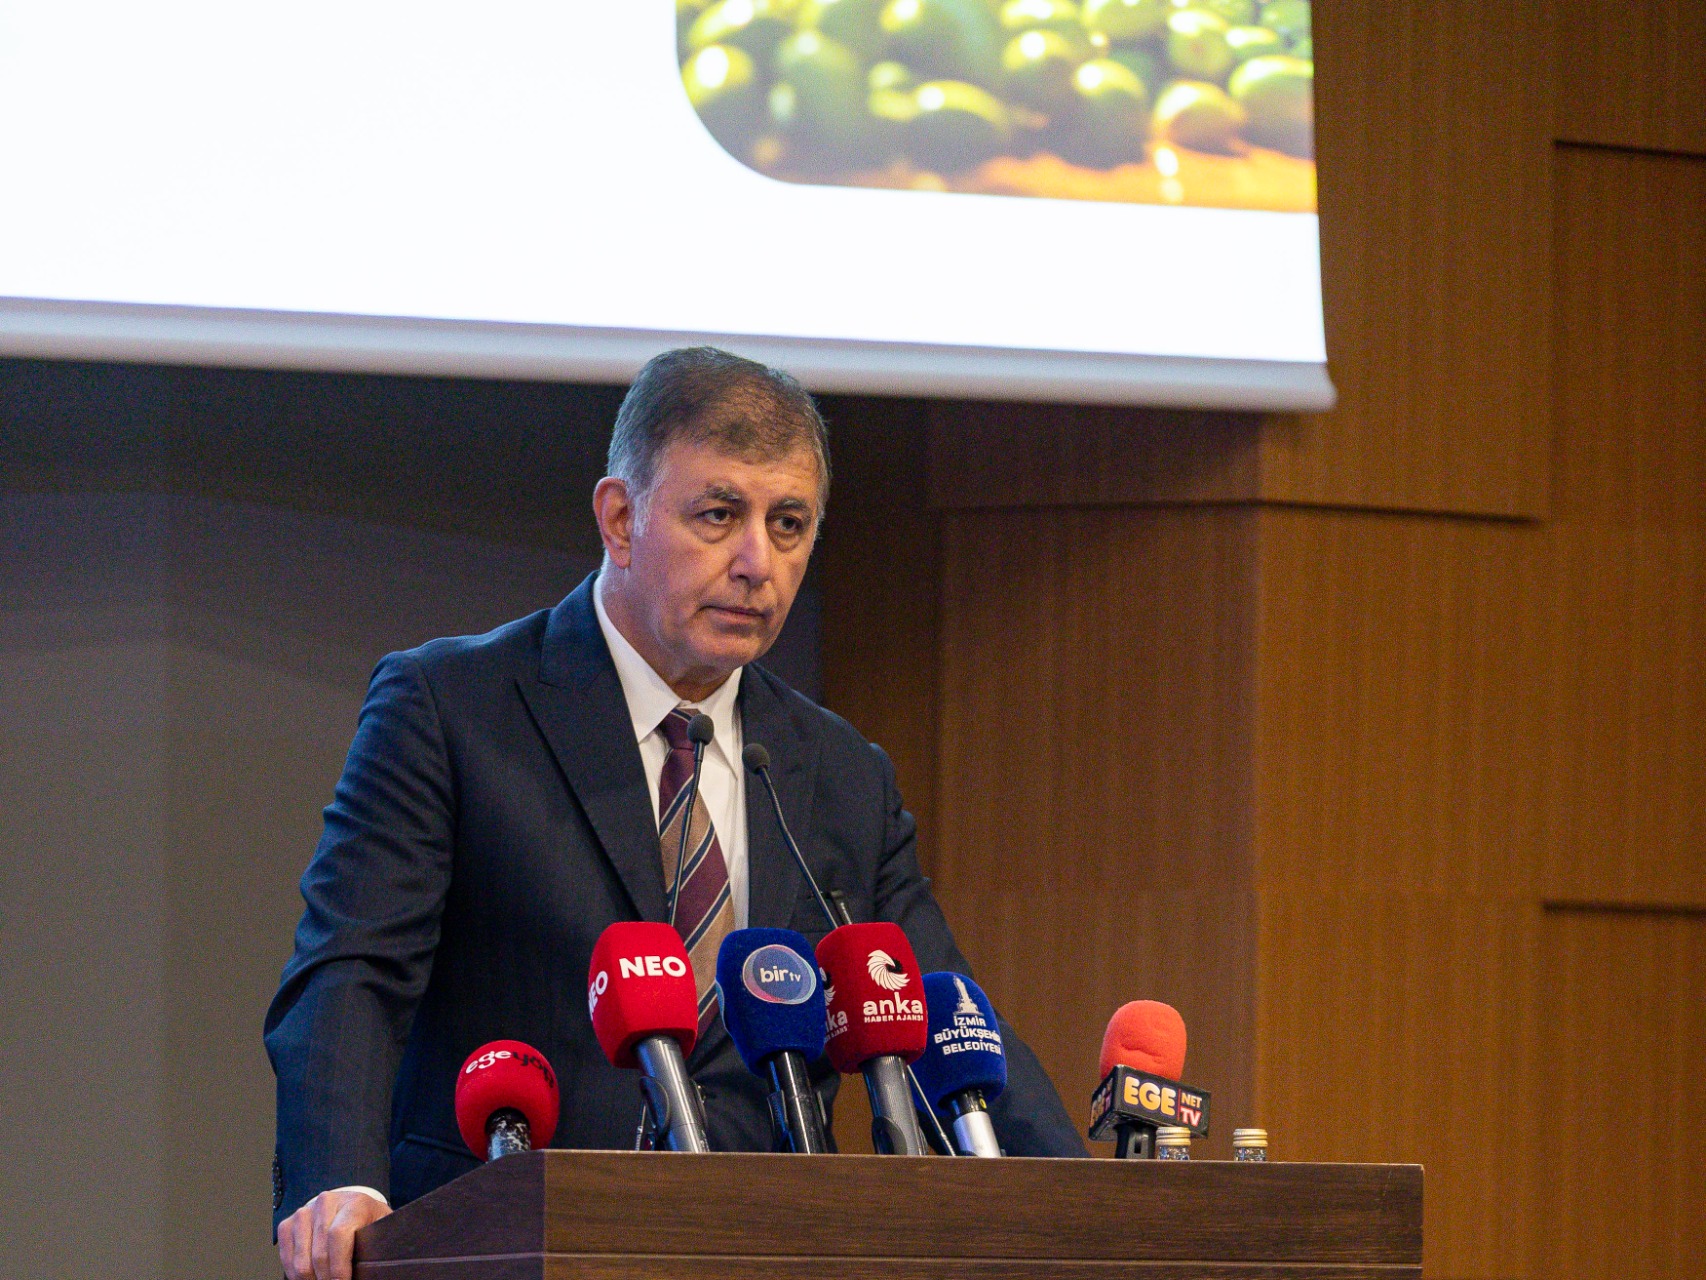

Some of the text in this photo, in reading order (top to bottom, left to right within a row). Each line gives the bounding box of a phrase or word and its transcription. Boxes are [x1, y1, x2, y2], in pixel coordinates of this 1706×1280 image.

[618, 955, 686, 979] NEO
[760, 965, 801, 983] bir tv
[863, 991, 923, 1015] anka
[864, 1015, 894, 1023] HABER
[953, 1015, 987, 1027] İZMİR
[942, 1039, 1002, 1056] BELEDİYESİ
[1123, 1076, 1176, 1116] EGE
[1181, 1092, 1202, 1108] NET
[1180, 1106, 1202, 1127] TV
